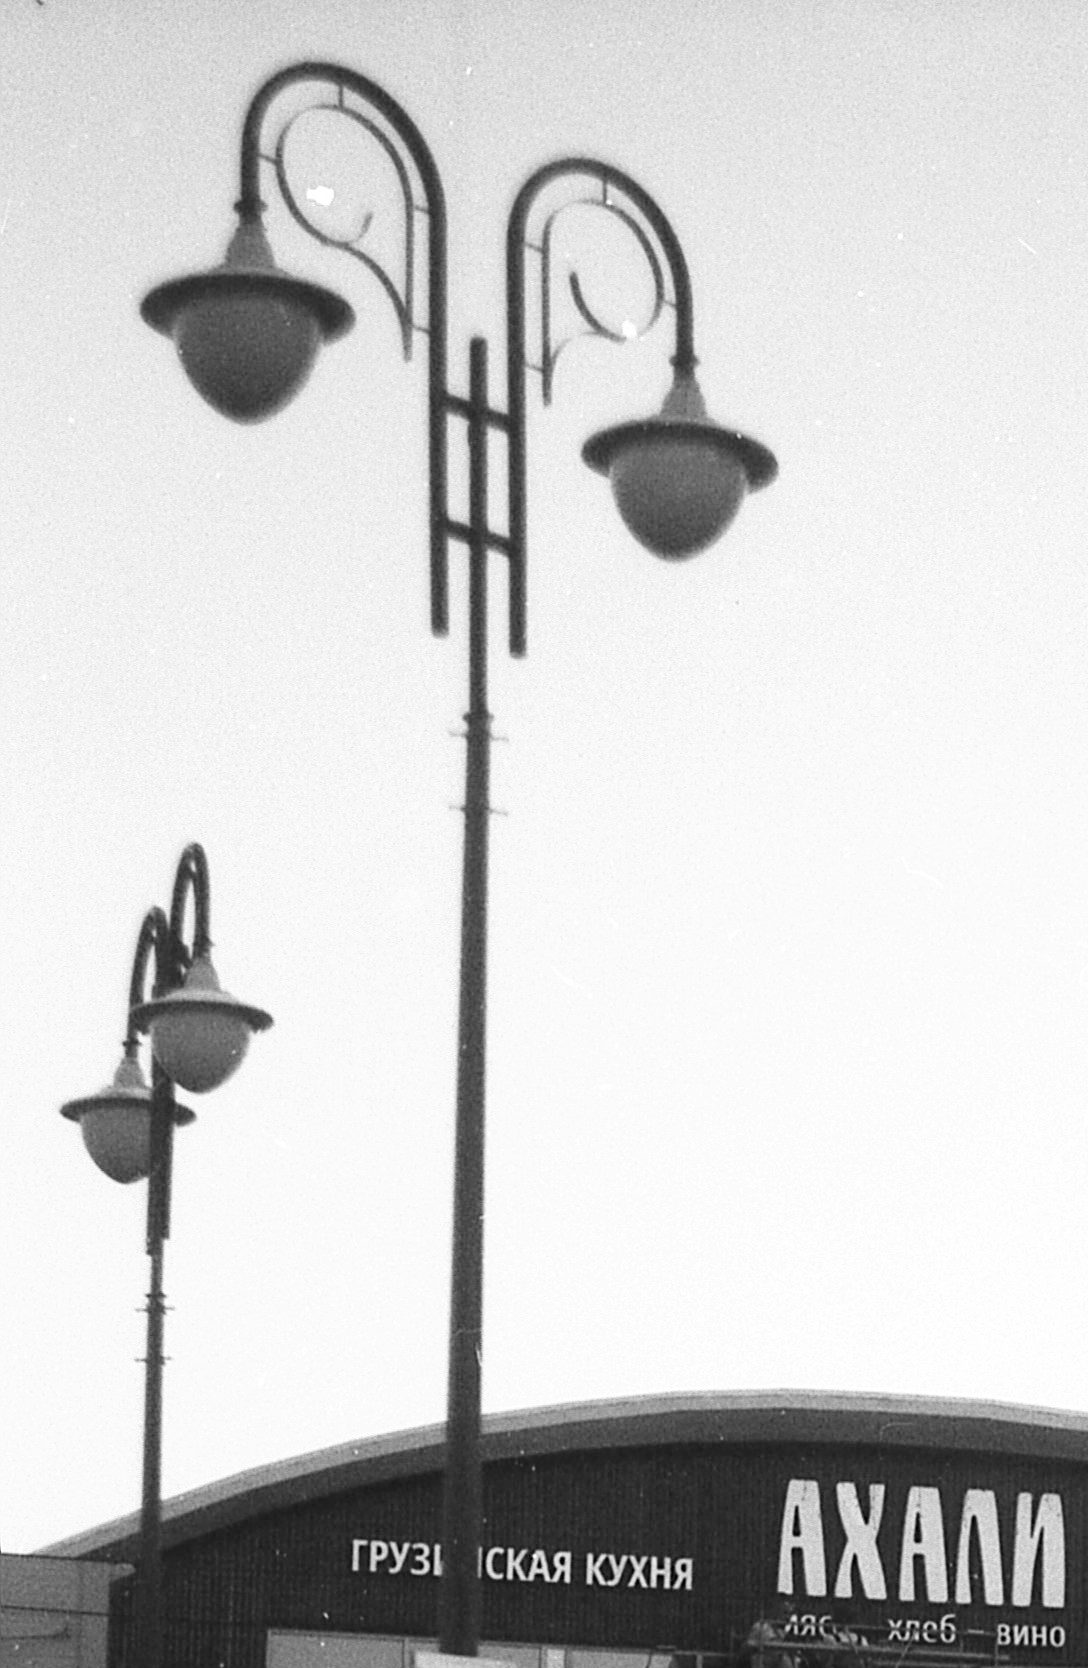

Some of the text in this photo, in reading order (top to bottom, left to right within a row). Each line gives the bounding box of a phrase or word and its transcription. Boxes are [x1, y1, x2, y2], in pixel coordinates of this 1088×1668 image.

[351, 1538, 693, 1591] ГРУЗСКАЯ КУХНЯ
[777, 1478, 1066, 1609] АХАЛИ
[888, 1613, 957, 1644] хлеб
[996, 1623, 1066, 1648] вино
